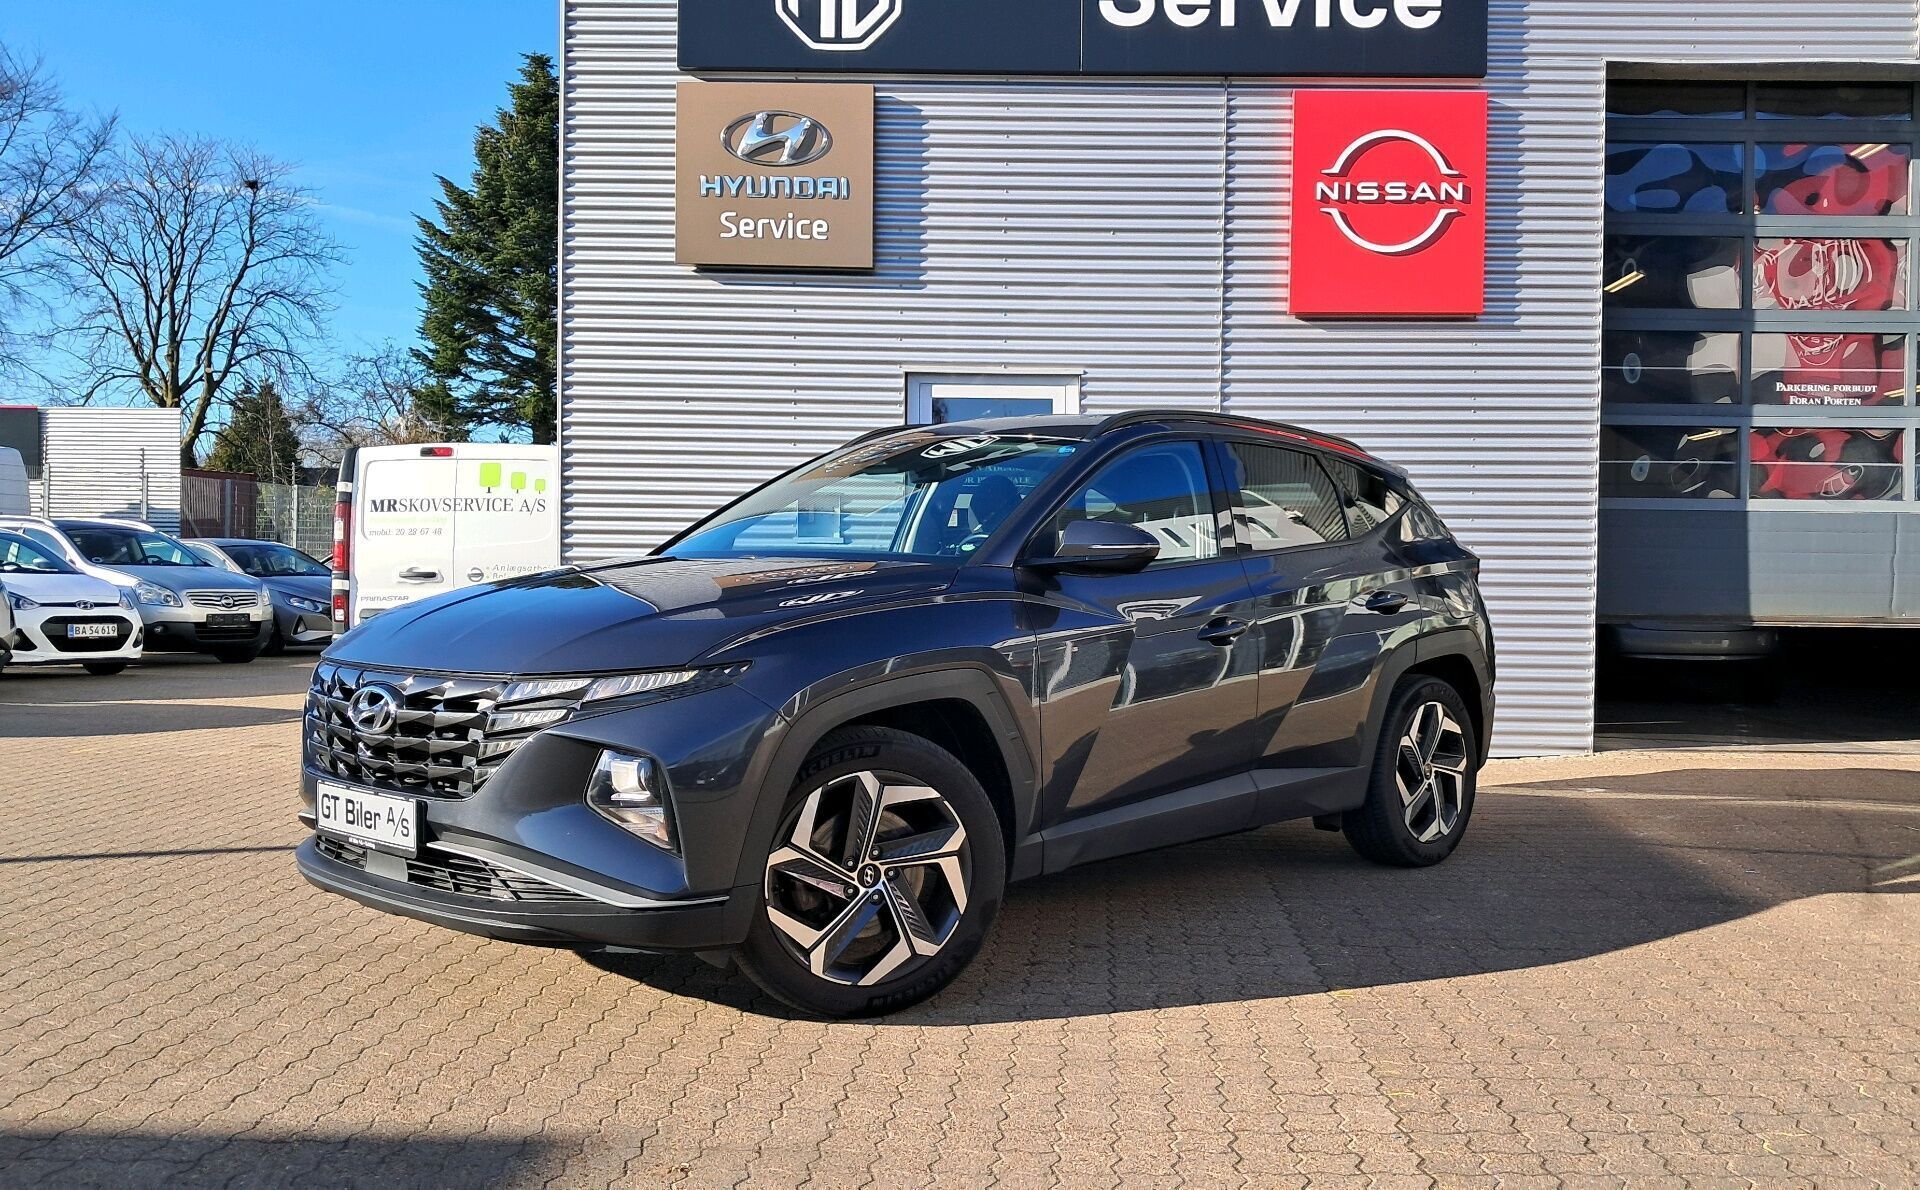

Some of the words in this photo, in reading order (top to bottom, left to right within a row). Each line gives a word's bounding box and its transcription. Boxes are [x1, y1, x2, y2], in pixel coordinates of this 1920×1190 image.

[699, 174, 850, 199] HYUNDAI
[1315, 181, 1464, 201] NISSAN
[719, 211, 829, 240] Service
[1789, 395, 1821, 405] FORAN
[1823, 396, 1861, 406] PORTEN
[370, 498, 513, 512] MRSKOVSERVICE
[519, 498, 546, 516] A/S
[75, 625, 87, 635] BA
[321, 793, 340, 821] GT
[345, 798, 381, 830] Biler
